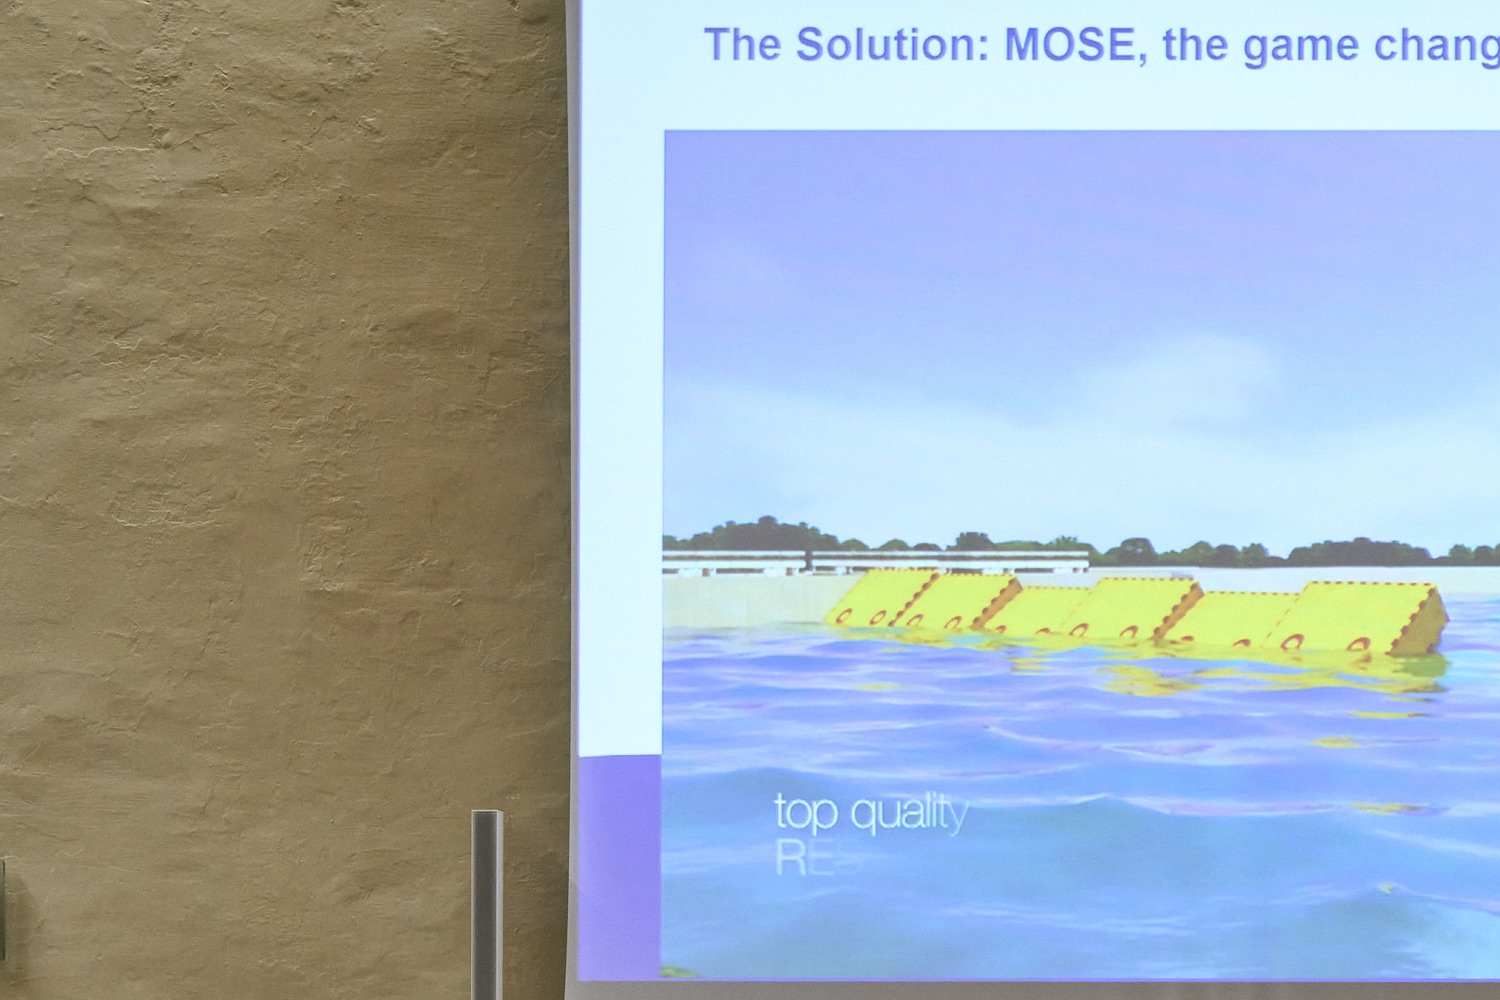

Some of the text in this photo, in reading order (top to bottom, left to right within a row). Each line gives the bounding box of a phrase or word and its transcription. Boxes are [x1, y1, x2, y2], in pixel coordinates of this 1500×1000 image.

[703, 26, 782, 62] The
[797, 26, 988, 62] Solution:
[1005, 26, 1147, 67] MOSE,
[1163, 27, 1228, 61] the
[1243, 34, 1360, 70] game
[774, 791, 970, 837] top quality
